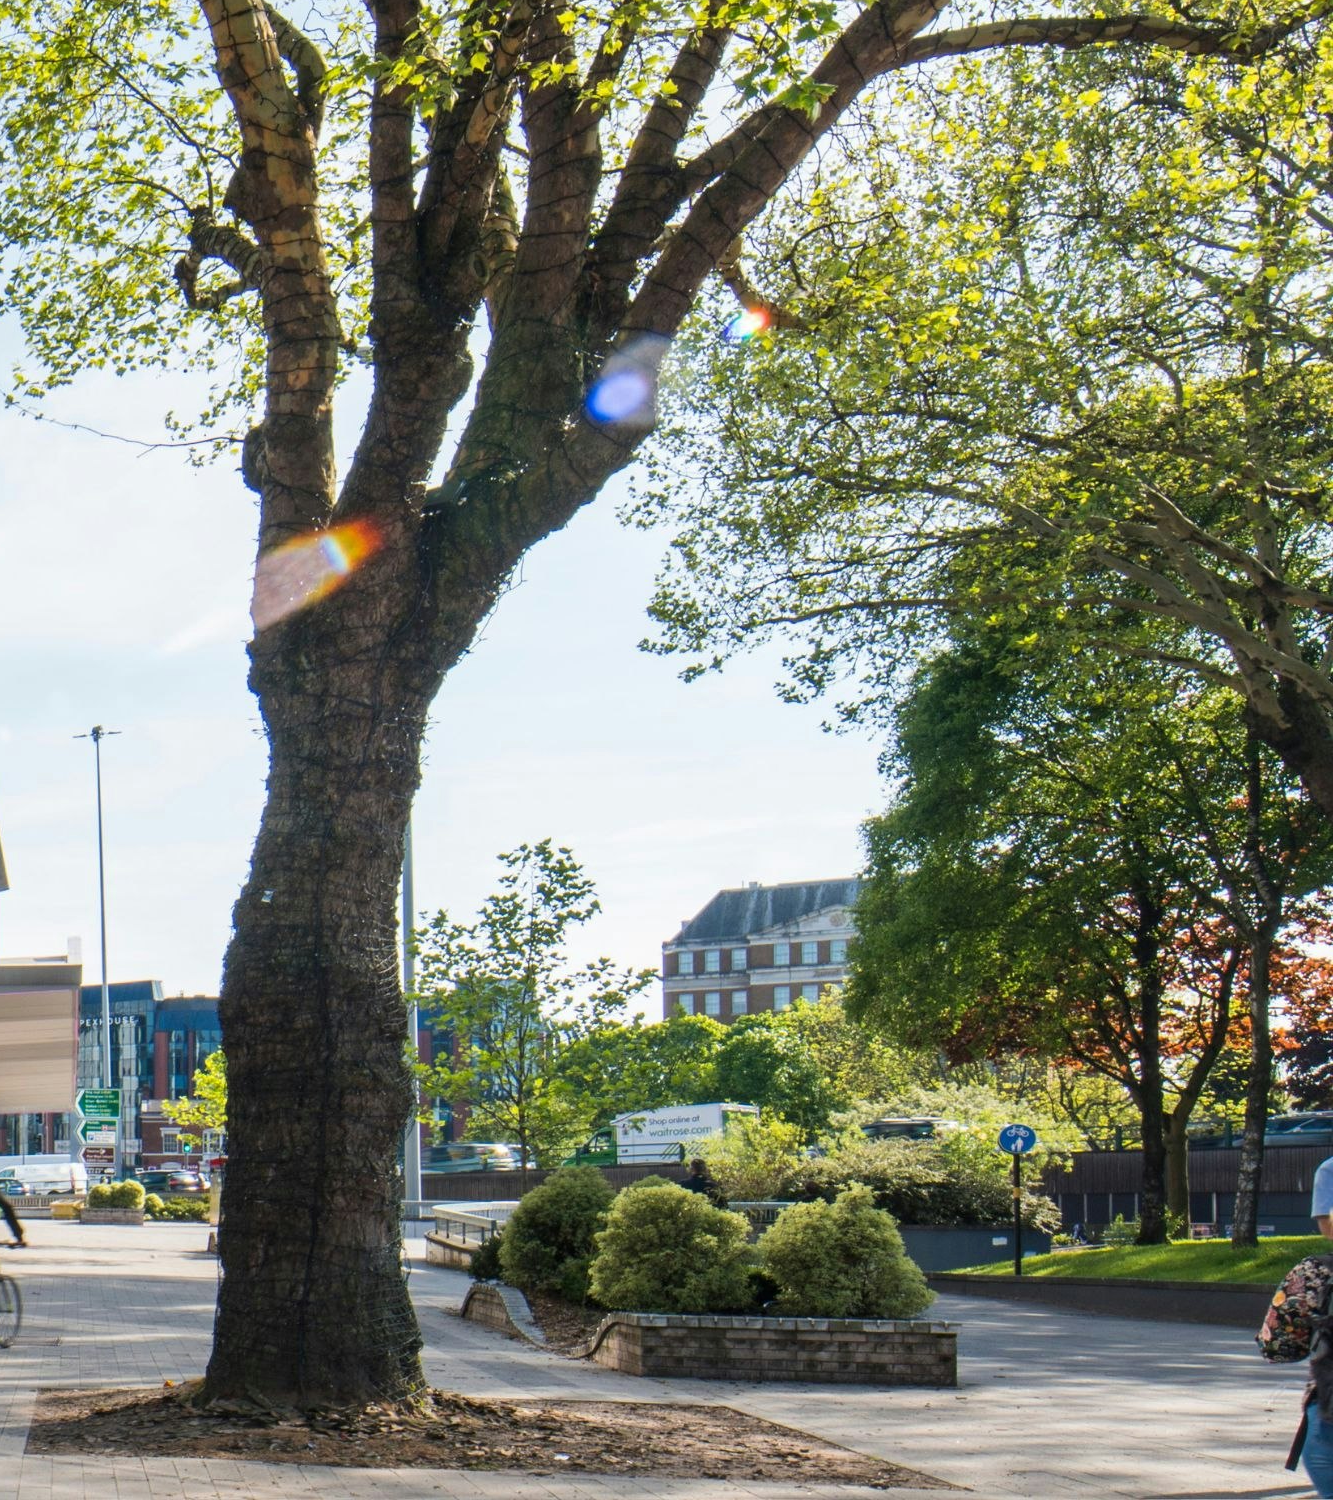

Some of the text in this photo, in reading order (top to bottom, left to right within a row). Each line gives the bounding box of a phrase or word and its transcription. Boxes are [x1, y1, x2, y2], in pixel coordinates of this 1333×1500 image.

[649, 1118, 667, 1126] Shop
[668, 1116, 690, 1124] online
[649, 1125, 713, 1137] waitrose.com
